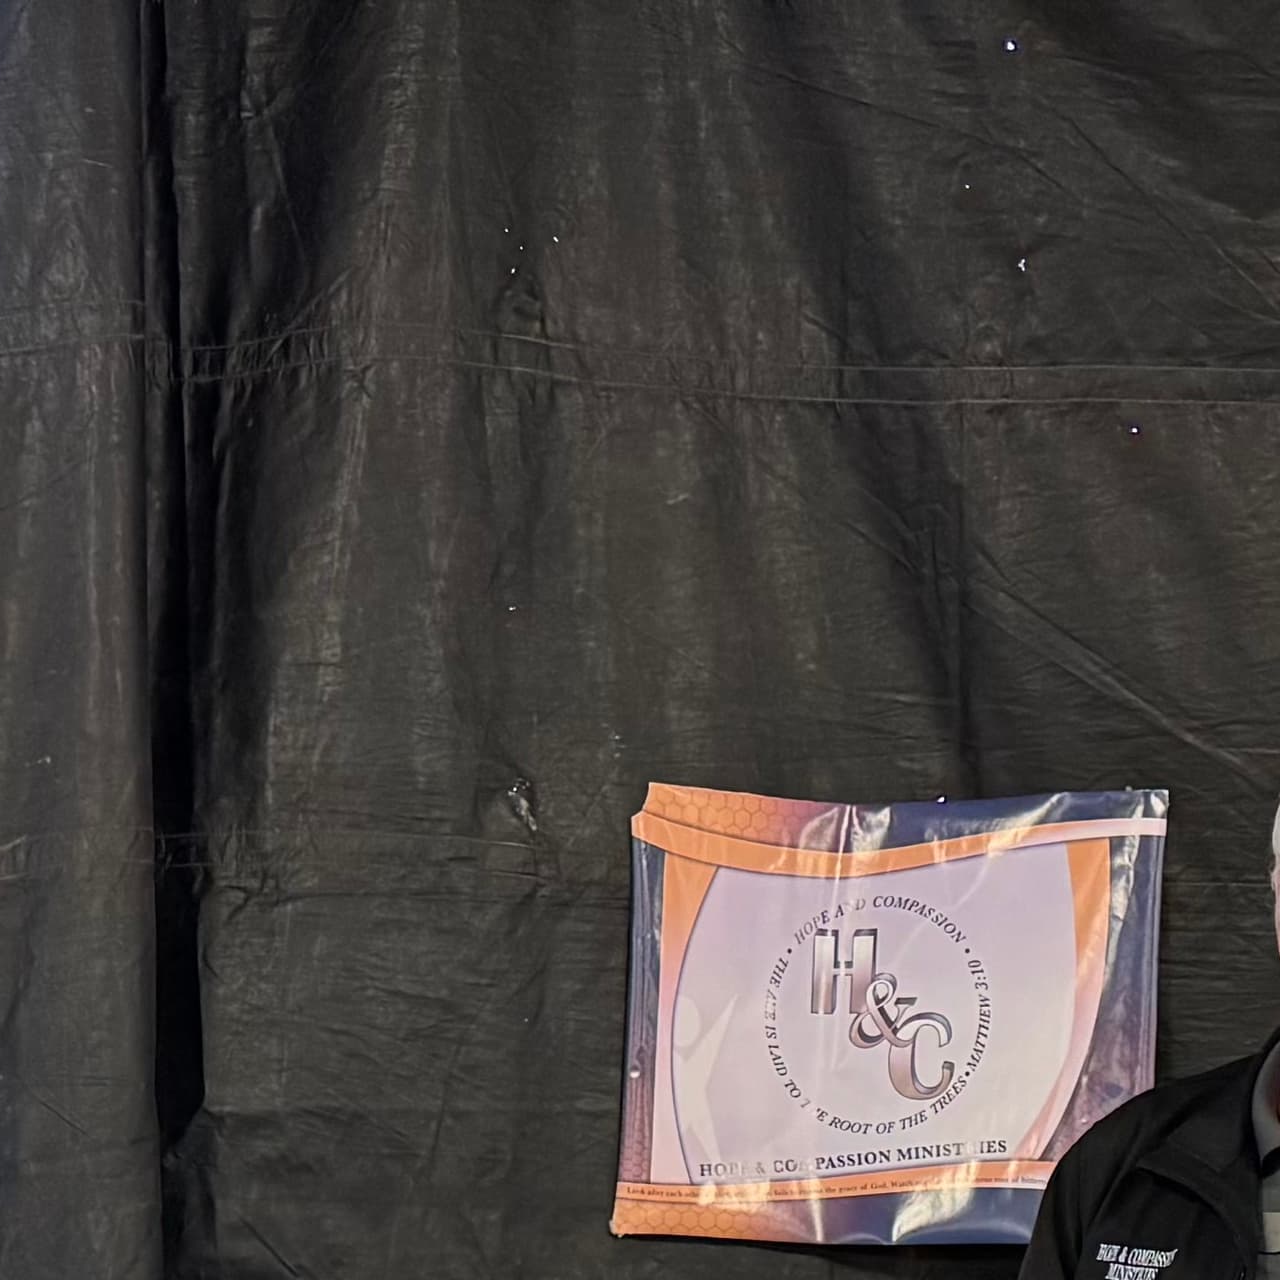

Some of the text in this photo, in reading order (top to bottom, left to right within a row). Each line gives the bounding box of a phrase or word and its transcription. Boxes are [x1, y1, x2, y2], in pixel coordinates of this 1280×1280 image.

[873, 895, 967, 944] COMPASSION
[967, 995, 992, 1072] MATTHEW
[829, 1075, 968, 1135] ROOT OF THE TREES
[773, 1140, 1008, 1172] COPASSION MINISTIES
